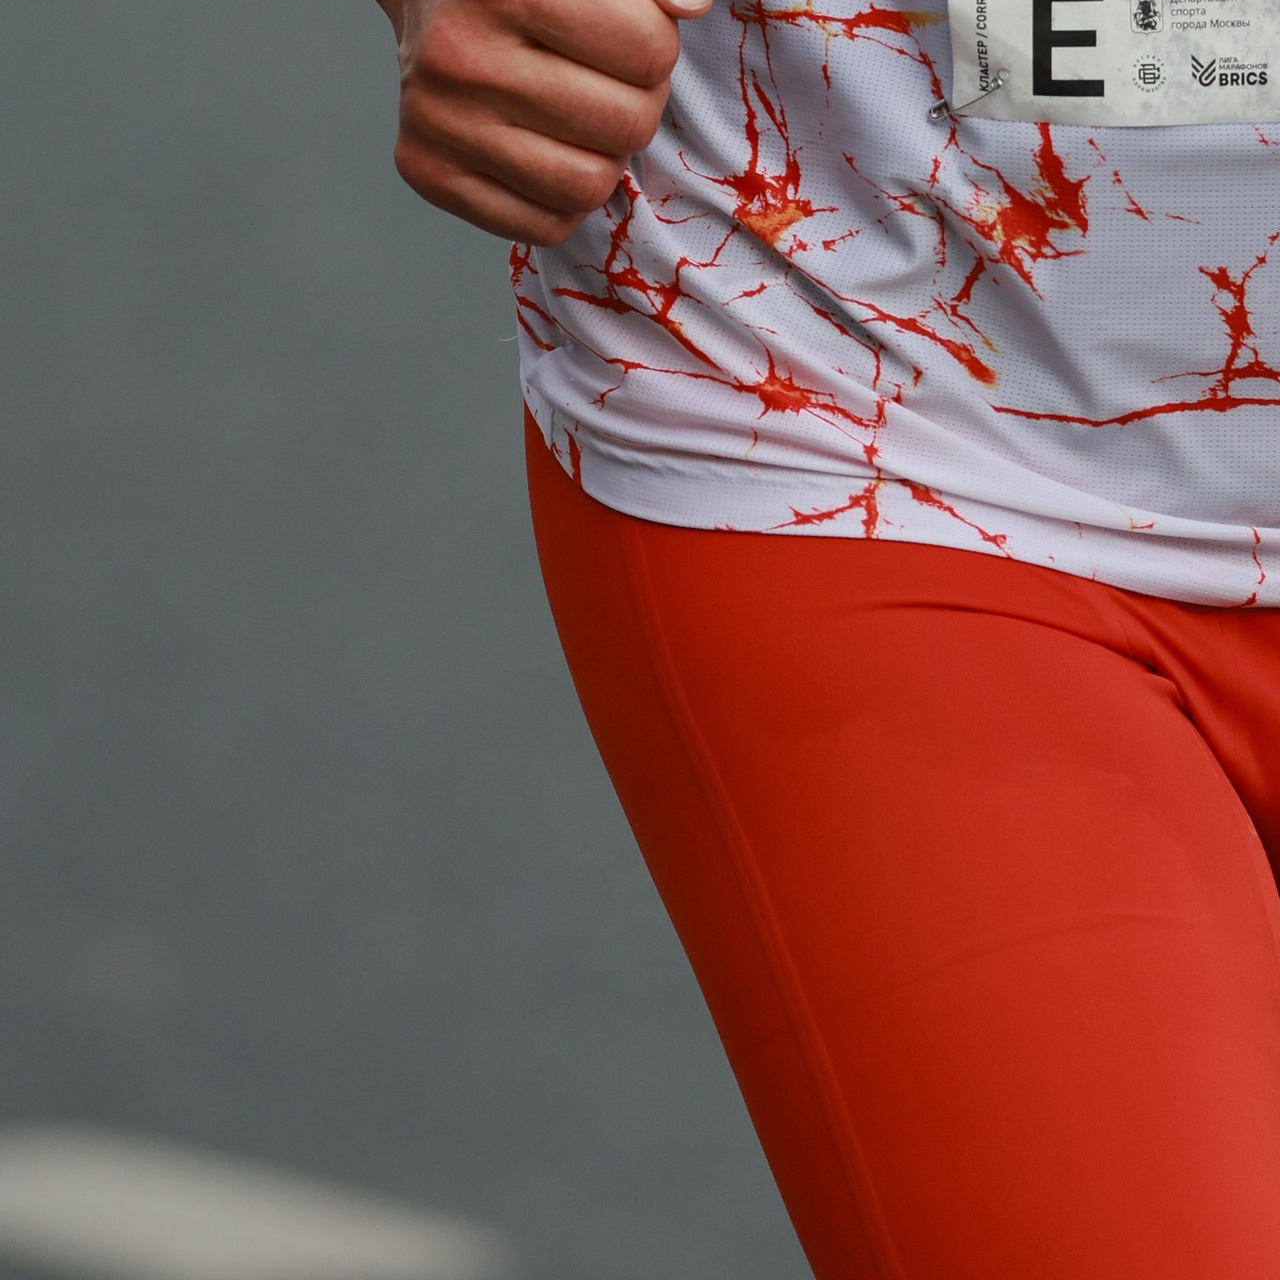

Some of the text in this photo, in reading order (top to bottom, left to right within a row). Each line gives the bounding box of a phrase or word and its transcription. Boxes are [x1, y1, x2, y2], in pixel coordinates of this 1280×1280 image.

[1170, 7, 1207, 18] спорта
[1171, 19, 1251, 32] города Москвы
[977, 40, 990, 92] КЛАСТЕР
[1219, 56, 1238, 64] ЛИГА
[1219, 63, 1268, 71] МАРАФОНОВ
[1219, 71, 1268, 87] BRICS
